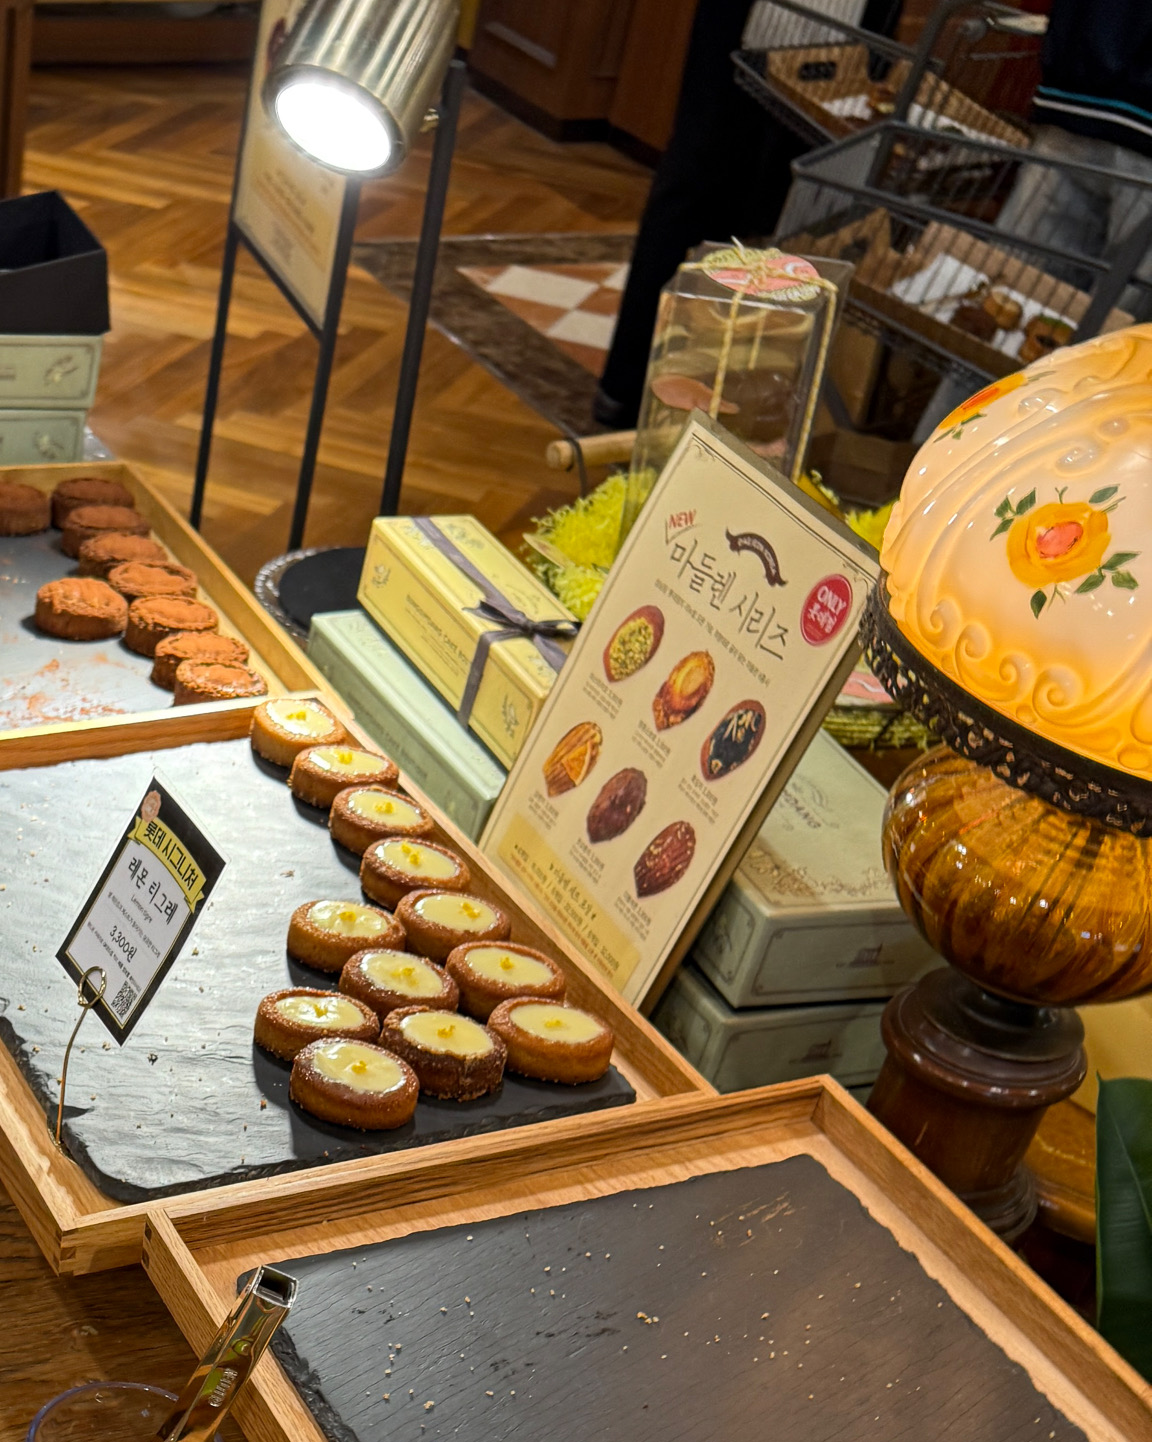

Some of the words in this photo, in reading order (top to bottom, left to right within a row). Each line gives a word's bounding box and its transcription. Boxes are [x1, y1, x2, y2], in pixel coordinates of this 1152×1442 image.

[669, 510, 696, 529] NEW
[817, 585, 847, 616] ONLY
[144, 821, 166, 847] 롯데
[162, 840, 199, 891] 시그니처
[128, 857, 149, 889] 레몬
[109, 925, 138, 962] 3,300원
